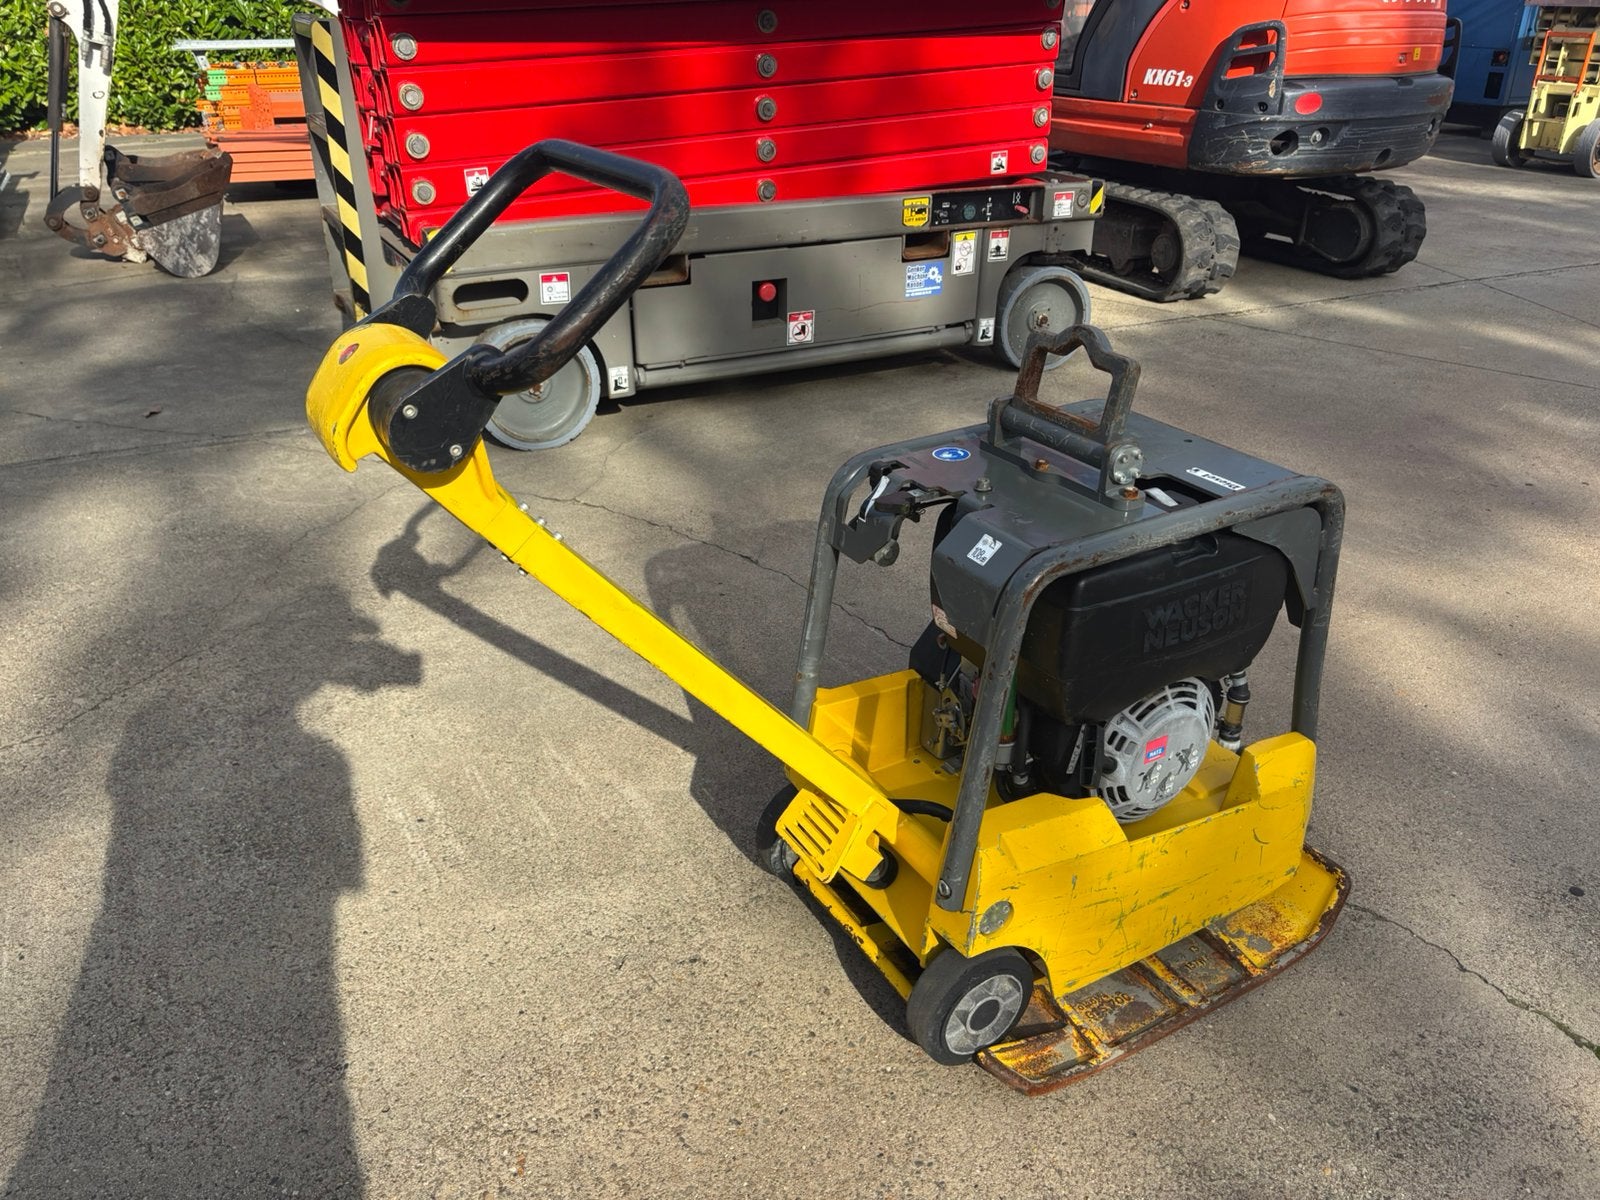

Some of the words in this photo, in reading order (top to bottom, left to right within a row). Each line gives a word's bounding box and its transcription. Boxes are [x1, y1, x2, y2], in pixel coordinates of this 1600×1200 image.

[1143, 68, 1193, 87] KX61-3
[1142, 581, 1247, 629] WACKER
[1143, 603, 1246, 653] NEUSON
